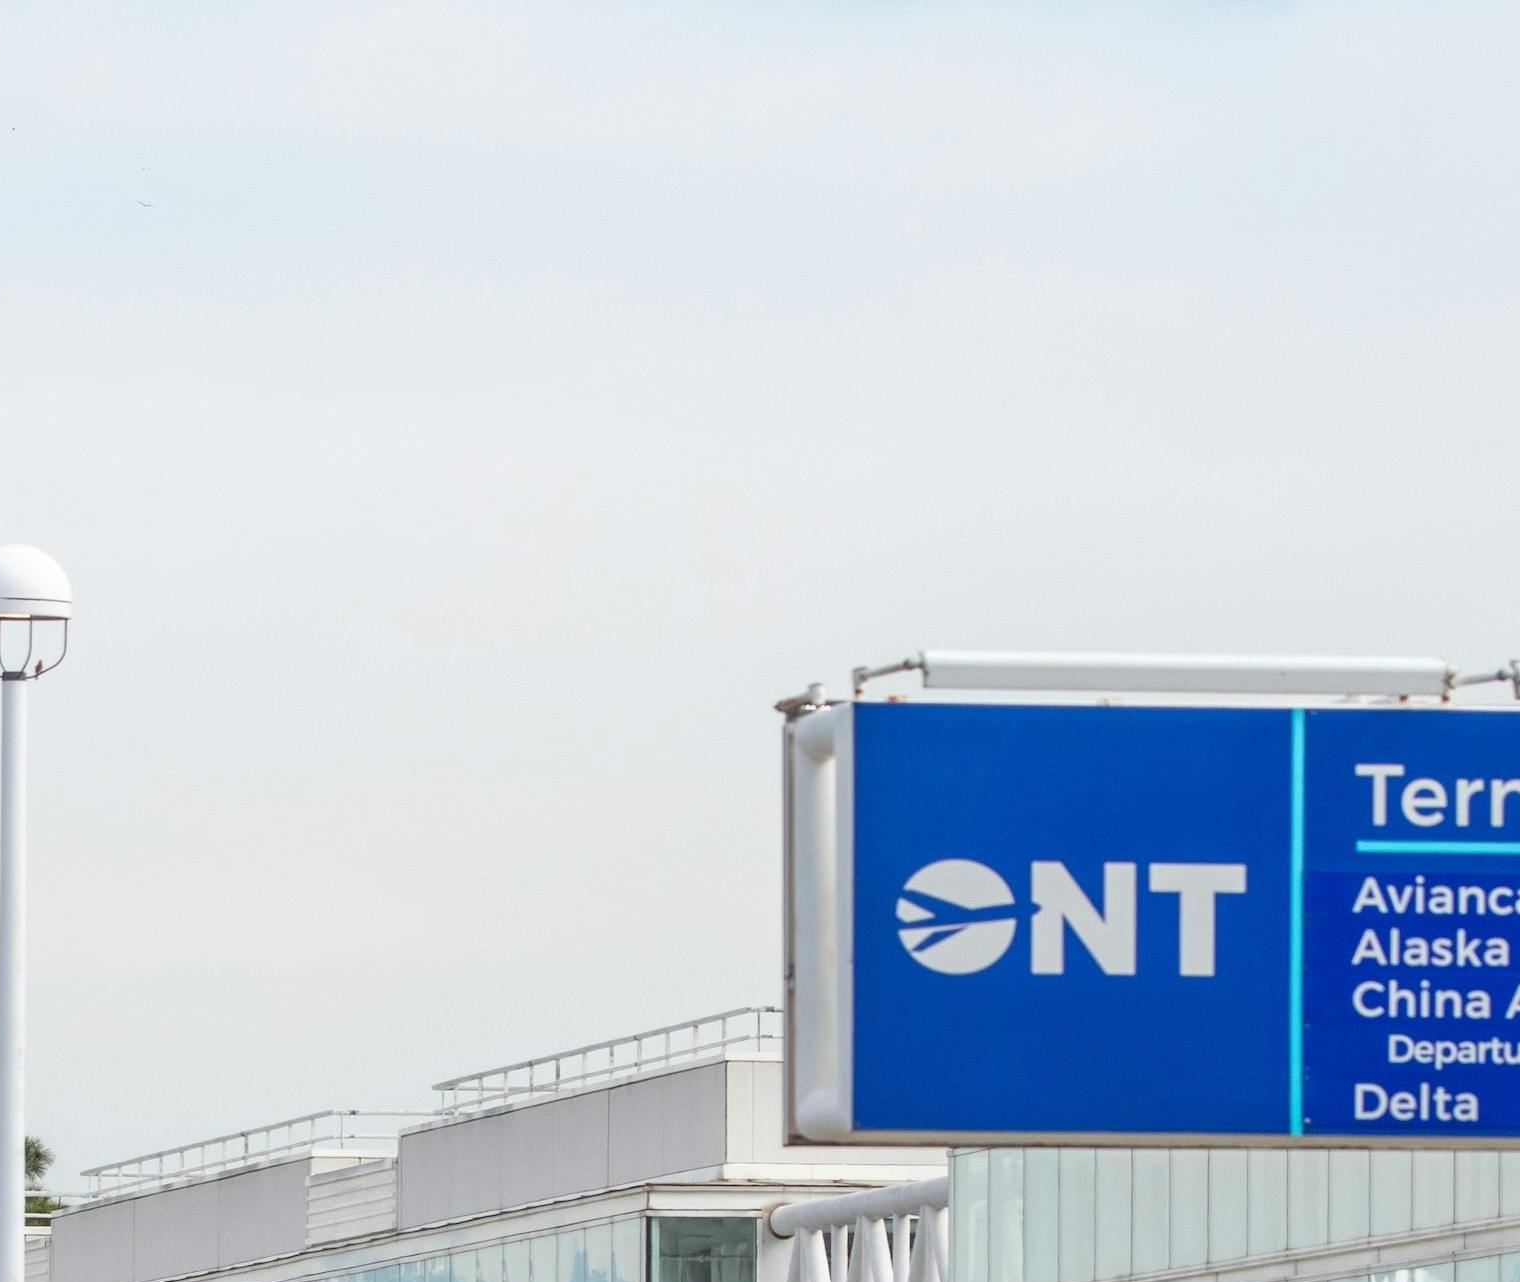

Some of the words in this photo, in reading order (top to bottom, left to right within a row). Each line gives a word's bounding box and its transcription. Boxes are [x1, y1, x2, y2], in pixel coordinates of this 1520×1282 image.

[895, 858, 1247, 977] ONT
[1352, 927, 1510, 967] Alaska
[1353, 979, 1491, 1019] China
[1354, 1082, 1479, 1122] Delta
